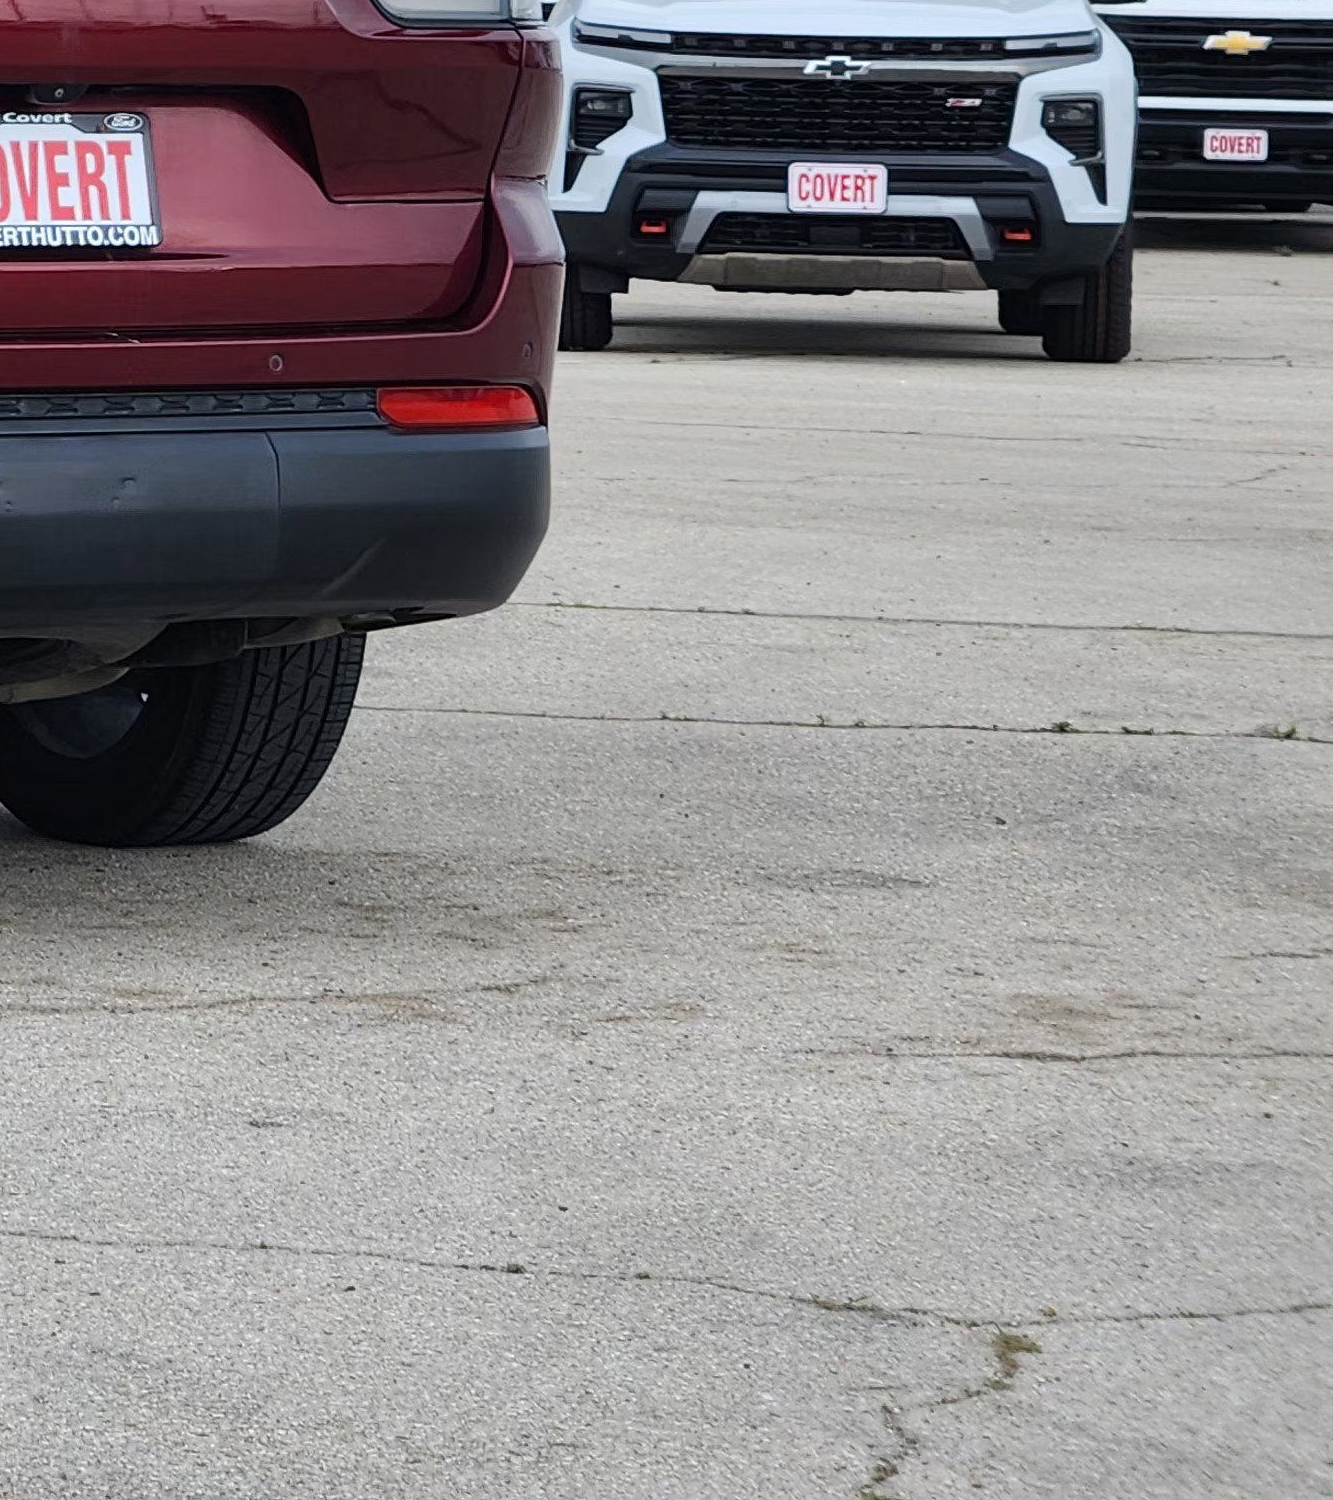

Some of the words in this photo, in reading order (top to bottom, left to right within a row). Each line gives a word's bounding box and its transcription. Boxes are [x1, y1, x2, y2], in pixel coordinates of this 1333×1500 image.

[2, 111, 73, 124] Covert
[1209, 135, 1262, 154] COVERT
[798, 173, 878, 203] COVERT
